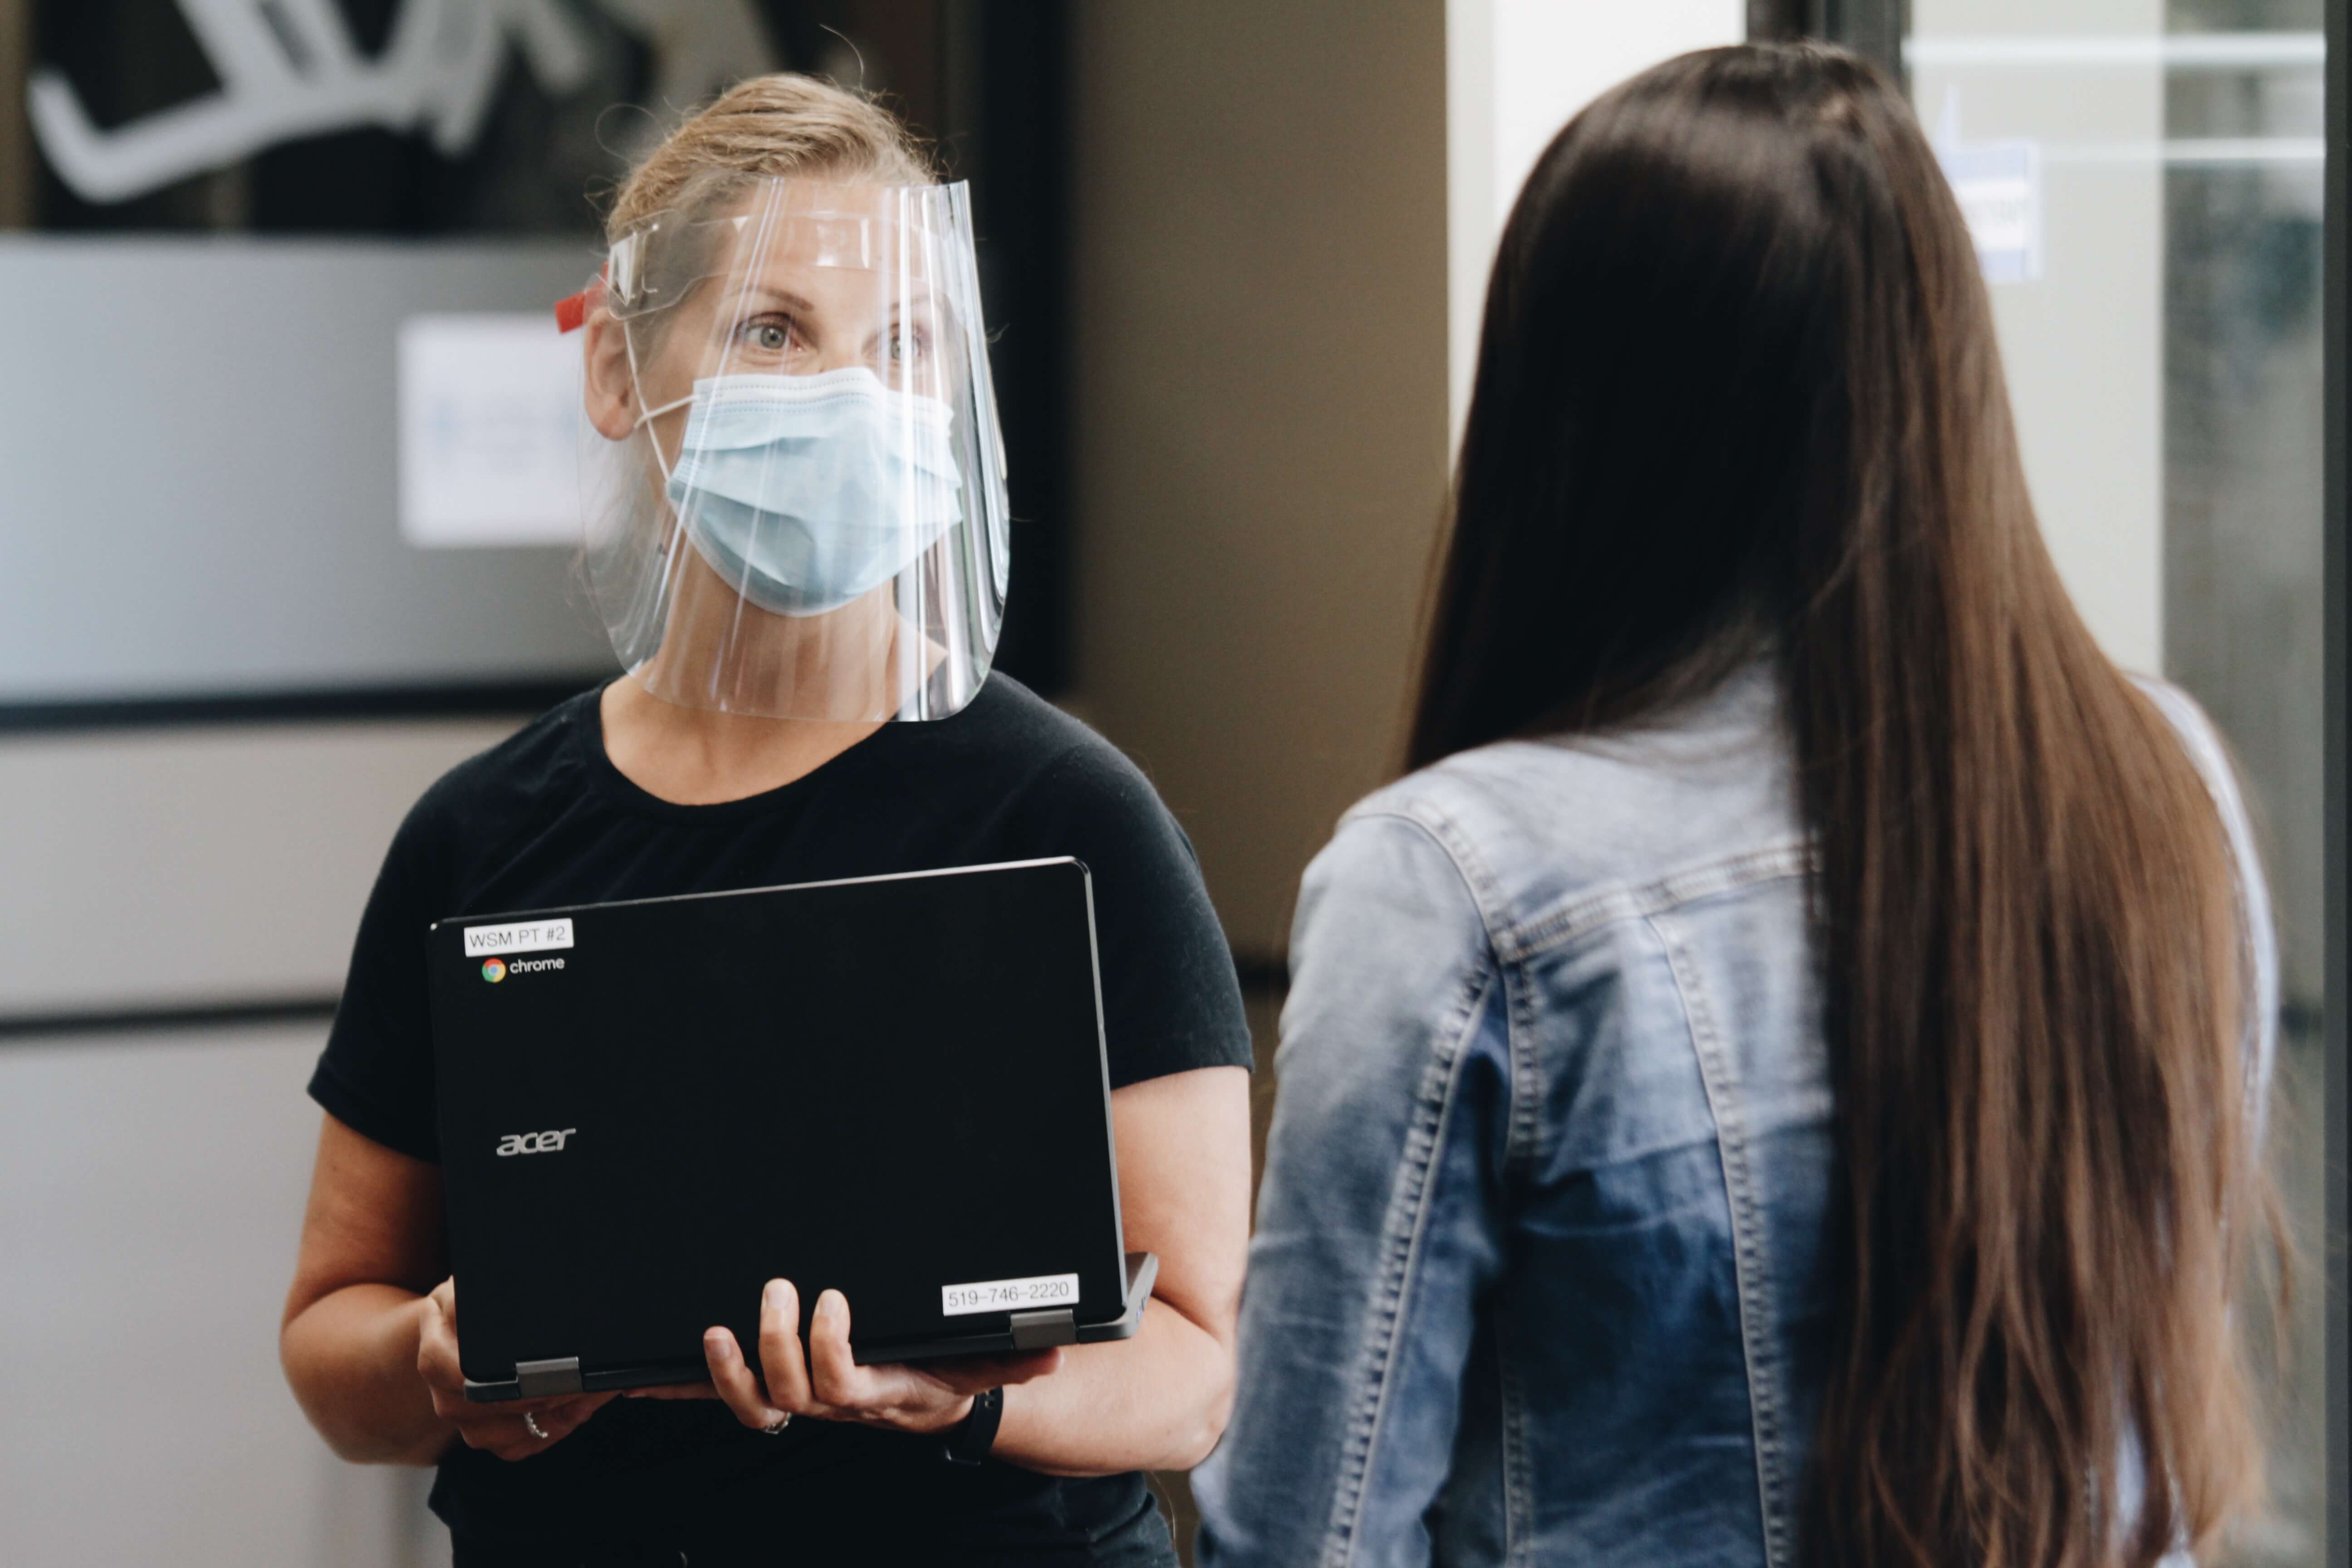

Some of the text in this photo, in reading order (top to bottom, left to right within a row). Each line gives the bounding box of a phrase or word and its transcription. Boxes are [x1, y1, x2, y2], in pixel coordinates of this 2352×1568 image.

[469, 926, 565, 948] WSM PT #2
[510, 958, 565, 974] chrome
[496, 1127, 576, 1156] acer
[948, 1281, 1069, 1307] 519-746-2220
